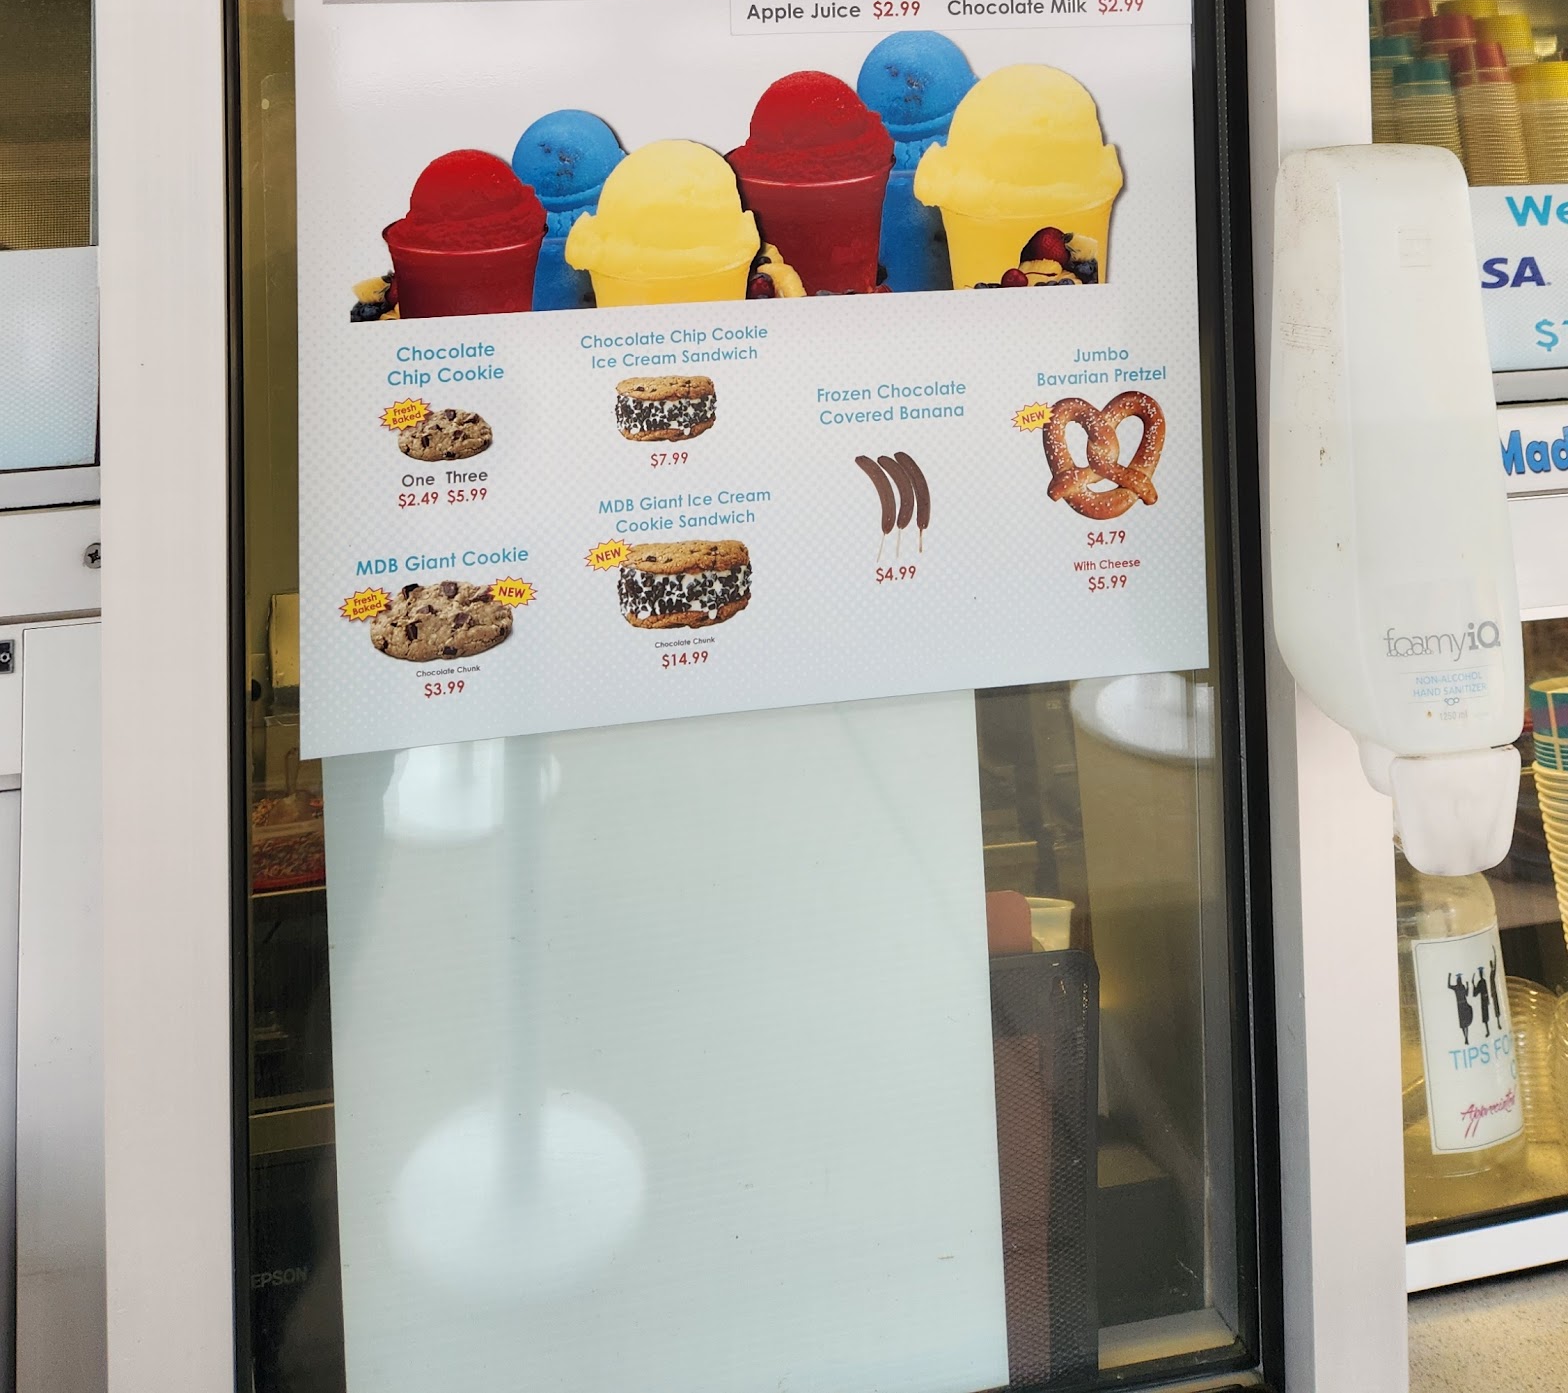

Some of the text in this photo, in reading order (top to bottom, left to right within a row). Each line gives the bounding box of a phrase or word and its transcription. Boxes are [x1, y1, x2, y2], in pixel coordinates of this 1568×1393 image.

[396, 342, 496, 363] Chocolate
[1073, 347, 1129, 364] Jumbo
[387, 365, 505, 390] Chip Cookie
[1036, 366, 1166, 387] Bavarian Pretzel
[817, 380, 967, 403] Frozen Chocolate
[391, 411, 422, 425] Baked
[392, 403, 417, 417] Fresh
[819, 403, 964, 425] Covered Banana
[1021, 410, 1045, 425] NEW
[401, 469, 488, 488] One Three
[398, 487, 487, 510] $2.49 $5.99
[1087, 530, 1126, 548] $4.79
[356, 547, 529, 577] MDB Giant Cookie
[1073, 557, 1141, 572] With Cheese
[875, 565, 916, 585] $4.99
[1088, 574, 1127, 592] $5.99
[498, 585, 525, 599] NEW
[416, 664, 480, 679] Chocolate Chunk
[424, 679, 465, 699] $3.99
[1448, 1043, 1490, 1070] TIPS
